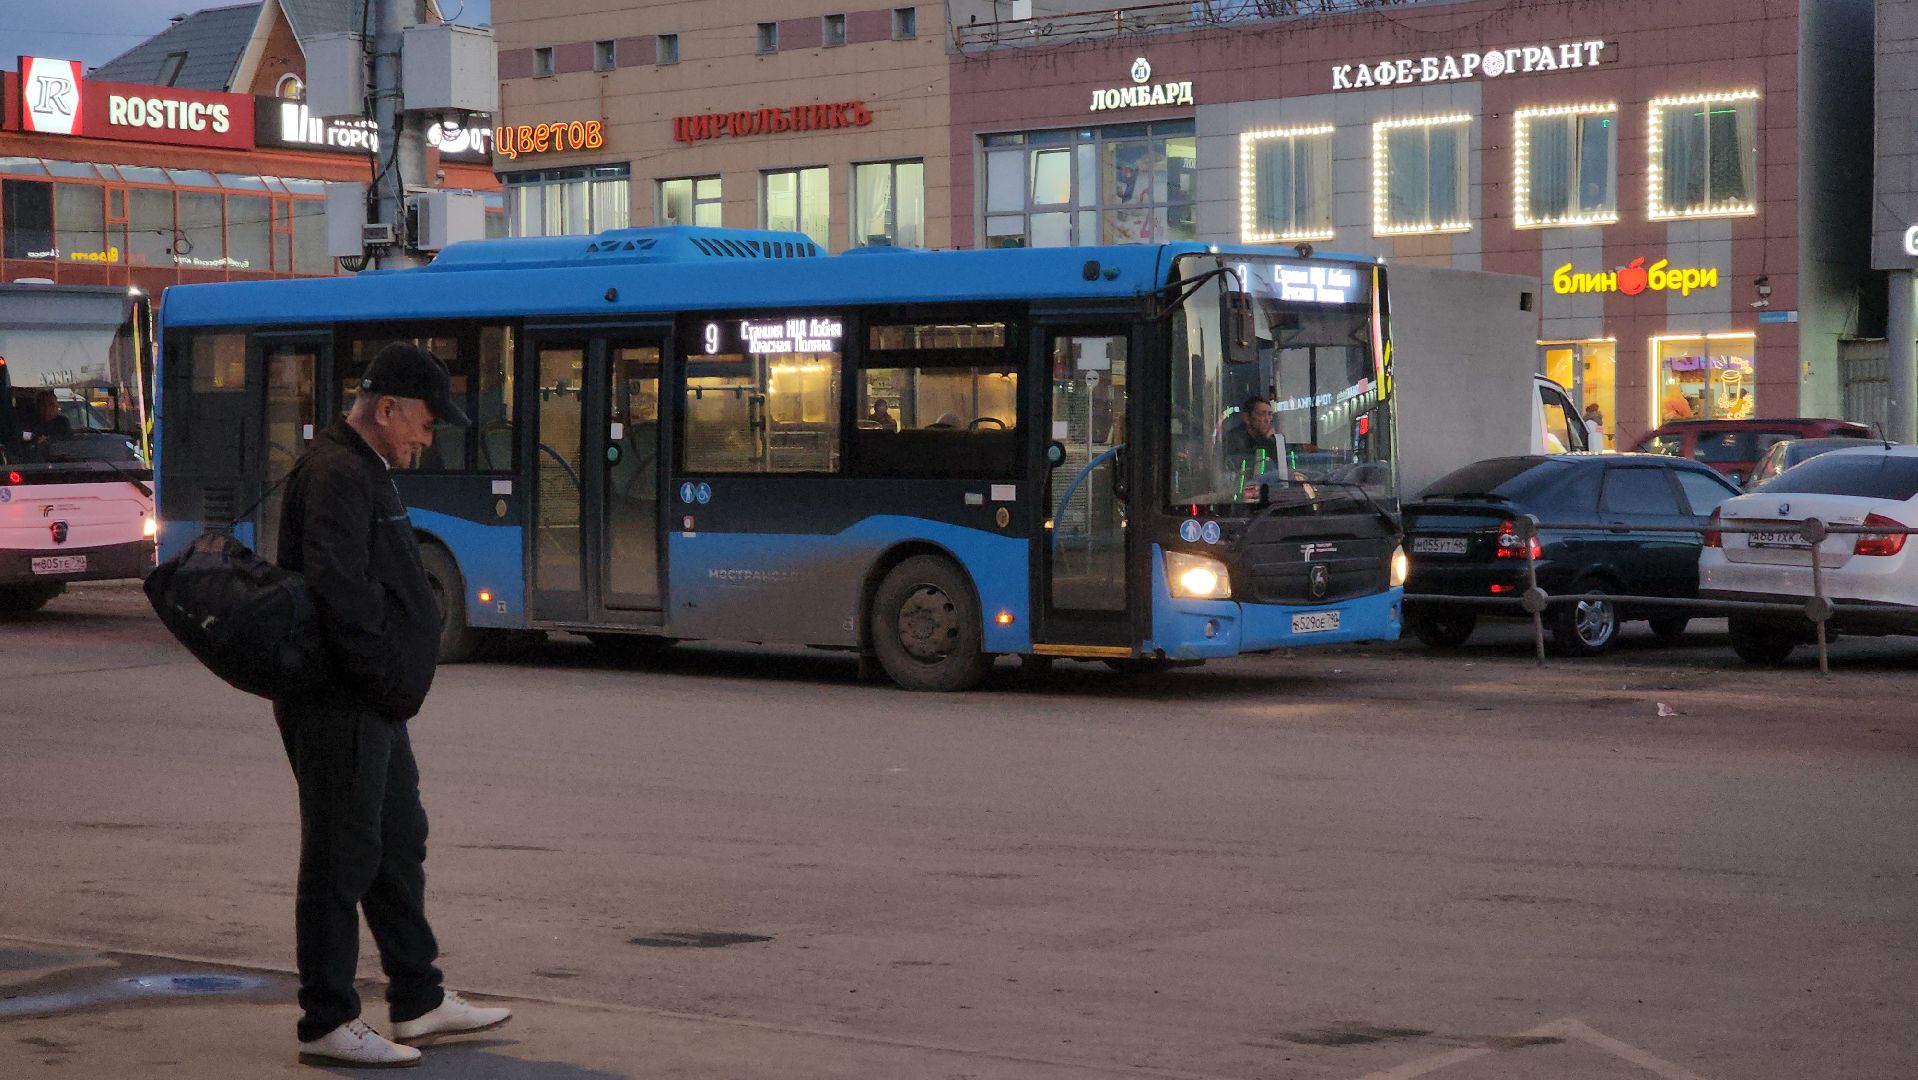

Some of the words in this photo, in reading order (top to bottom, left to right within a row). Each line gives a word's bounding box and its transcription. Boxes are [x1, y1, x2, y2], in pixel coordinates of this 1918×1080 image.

[1332, 53, 1481, 89] КАФЕ-БАР
[34, 76, 71, 115] R
[1090, 82, 1193, 111] ЛОМБАРД
[110, 95, 229, 133] ROSTIC'S
[673, 101, 873, 144] ЦИРЮЛЬНИКЪ
[1553, 262, 1617, 294] блин
[1648, 259, 1718, 297] бери
[705, 323, 719, 354] 9
[809, 318, 842, 338] Лобня
[749, 339, 793, 354] Красная
